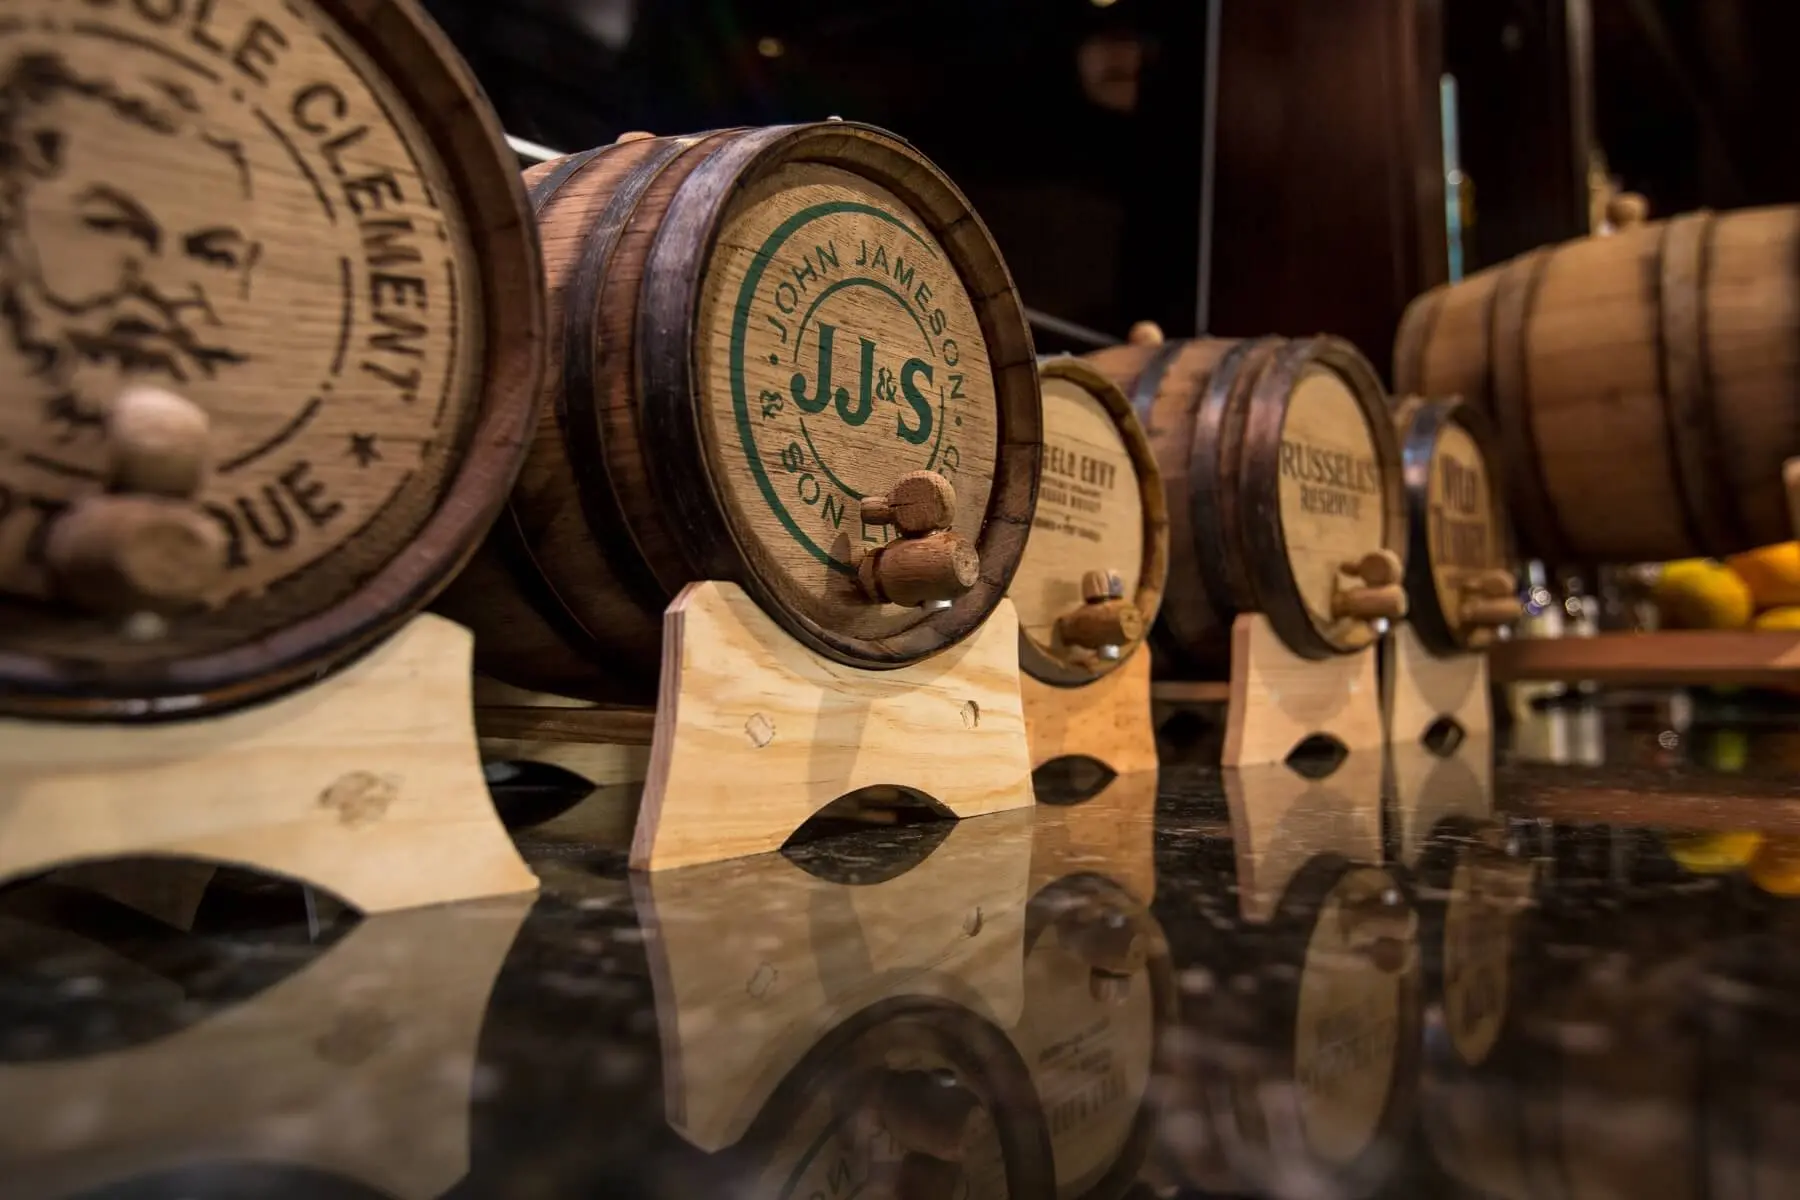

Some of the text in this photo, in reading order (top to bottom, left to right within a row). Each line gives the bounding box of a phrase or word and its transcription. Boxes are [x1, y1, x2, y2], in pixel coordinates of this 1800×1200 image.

[768, 239, 967, 400] JOHN JAMESON
[789, 321, 935, 445] JJ&S
[780, 441, 846, 530] SON
